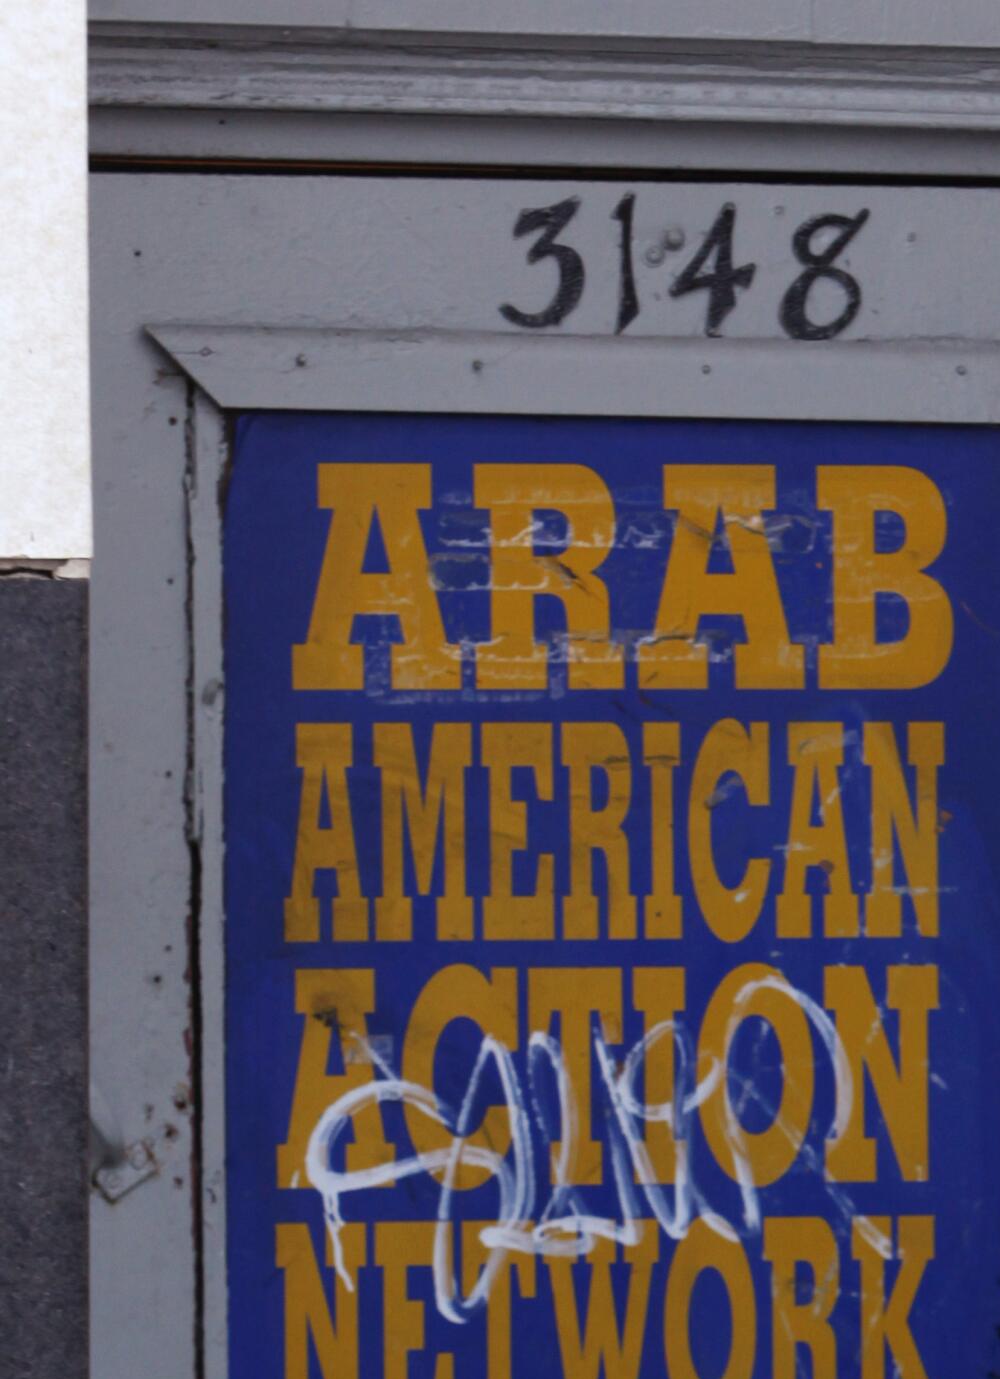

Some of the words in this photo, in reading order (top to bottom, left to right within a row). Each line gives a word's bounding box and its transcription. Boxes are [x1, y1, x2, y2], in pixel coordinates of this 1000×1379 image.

[499, 191, 871, 341] 3148
[292, 462, 954, 691] ARAB
[283, 717, 945, 943] AMERICAN
[275, 963, 940, 1191] ACTION
